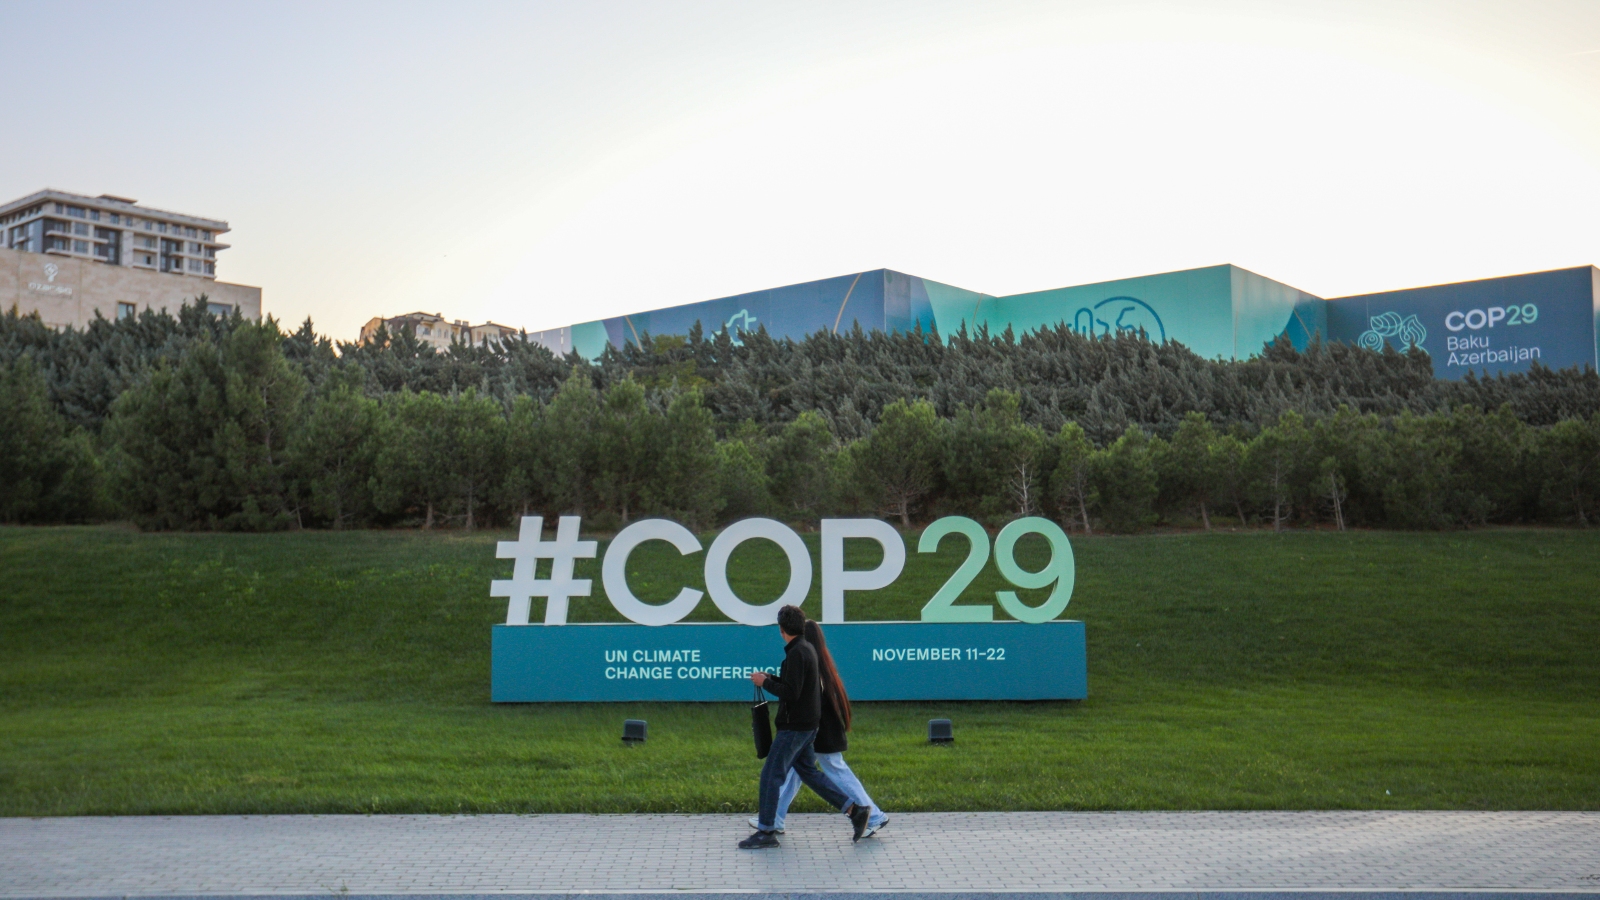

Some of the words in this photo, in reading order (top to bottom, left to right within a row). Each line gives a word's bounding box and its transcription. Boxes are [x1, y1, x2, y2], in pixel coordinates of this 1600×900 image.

[1445, 303, 1538, 332] COP29
[1447, 335, 1489, 351] Baku
[1447, 345, 1541, 367] Azerbaijan
[490, 516, 1075, 626] #COP29
[605, 650, 628, 663] UN
[632, 649, 701, 663] CLIMATE
[872, 648, 961, 661] NOVEMBER
[605, 666, 673, 680] CHANGE
